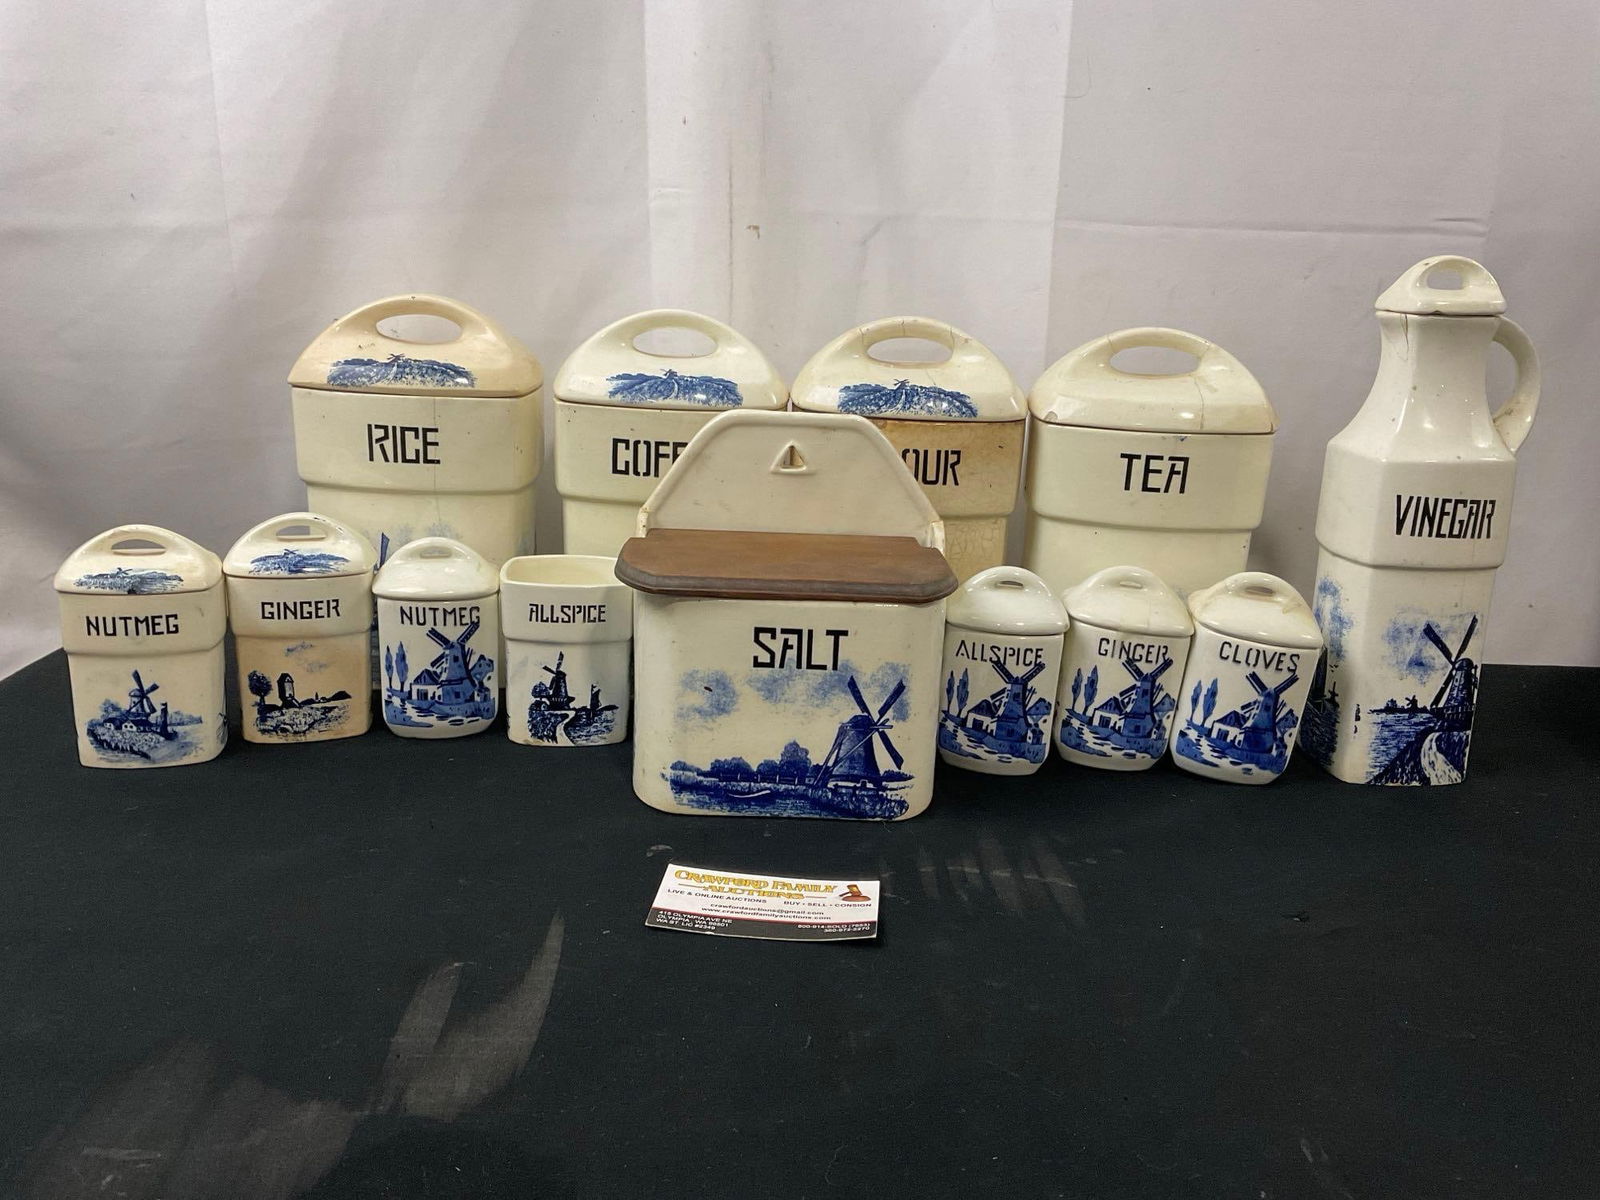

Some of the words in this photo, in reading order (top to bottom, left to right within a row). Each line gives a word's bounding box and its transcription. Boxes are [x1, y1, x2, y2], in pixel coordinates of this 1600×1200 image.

[367, 423, 441, 466] RICE
[1120, 452, 1190, 494] TEA
[1396, 494, 1496, 539] VINEGAR
[261, 598, 342, 621] GINGER
[400, 605, 481, 627] NUTMEG
[528, 602, 607, 624] ALLSPICE
[86, 613, 181, 638] NUTMEG
[753, 626, 849, 671] SALT
[955, 640, 1044, 667] ALLSPICE
[1098, 637, 1169, 665] GINGER
[1219, 639, 1301, 674] CLOVES
[674, 869, 769, 889] CRAWFORD
[772, 880, 838, 893] FAMILY
[703, 885, 806, 900] AUCTIONS
[695, 891, 725, 900] ONLINE
[726, 896, 767, 904] AUCTIONS
